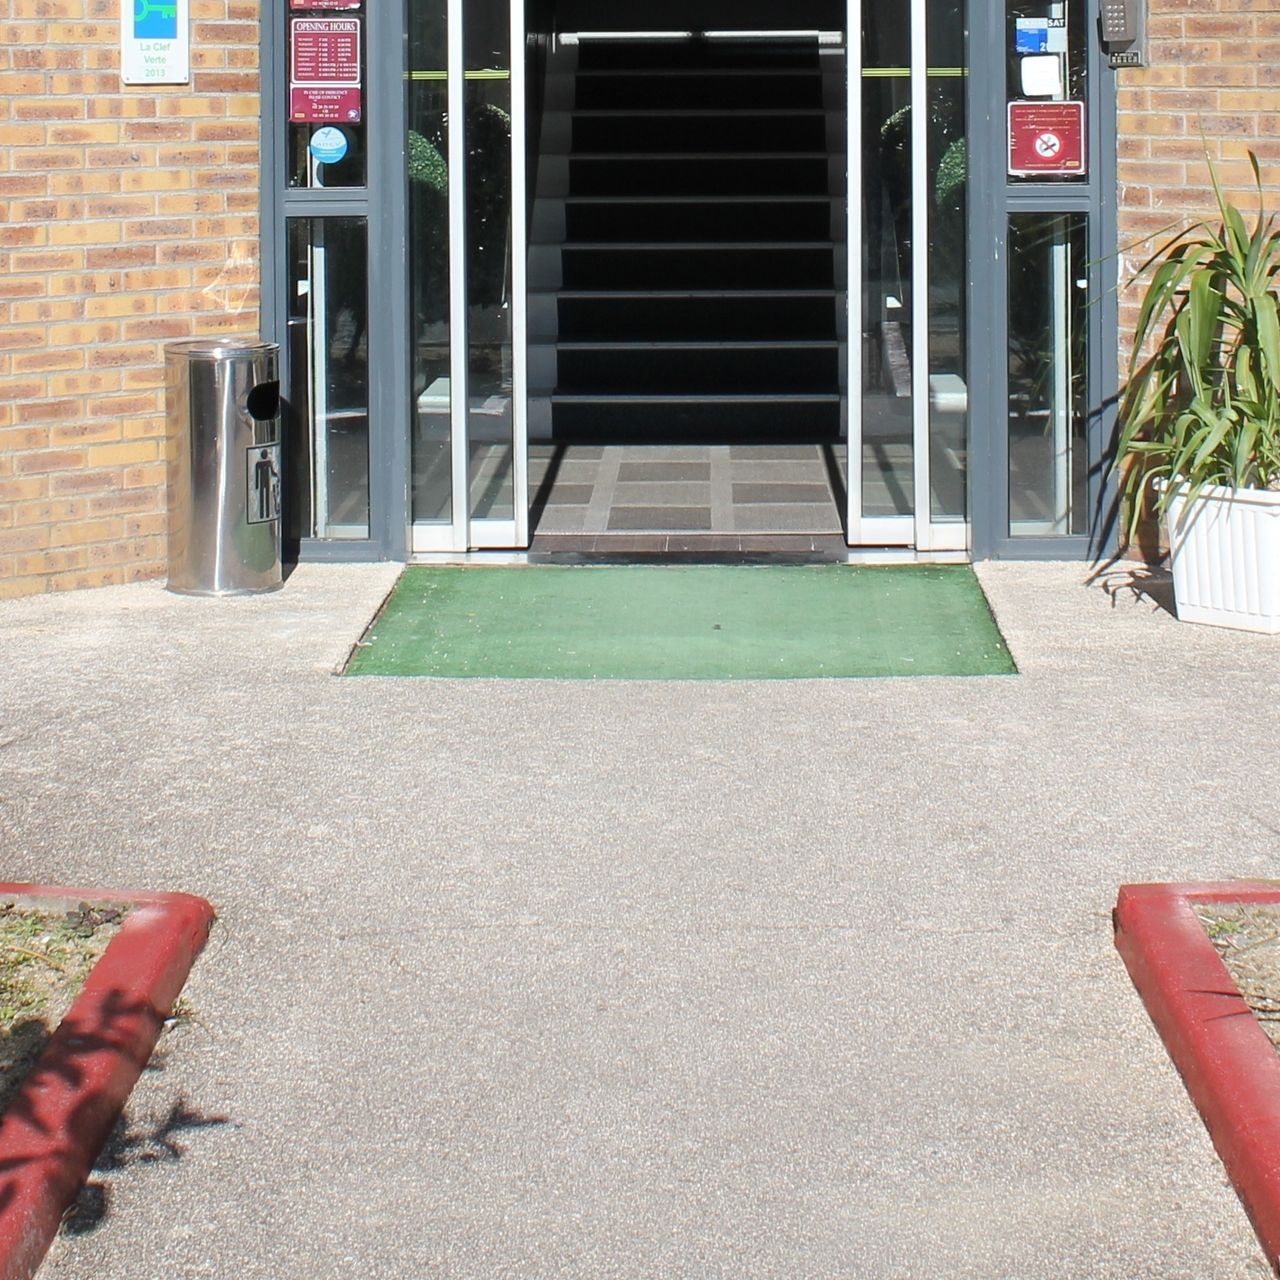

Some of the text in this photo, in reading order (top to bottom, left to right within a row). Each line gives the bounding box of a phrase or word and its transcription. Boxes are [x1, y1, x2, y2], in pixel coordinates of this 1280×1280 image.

[297, 22, 355, 31] OPENING HOURS
[1048, 19, 1064, 27] SAT
[140, 42, 170, 51] La Clef
[144, 55, 167, 64] Verte
[145, 69, 166, 77] 2013
